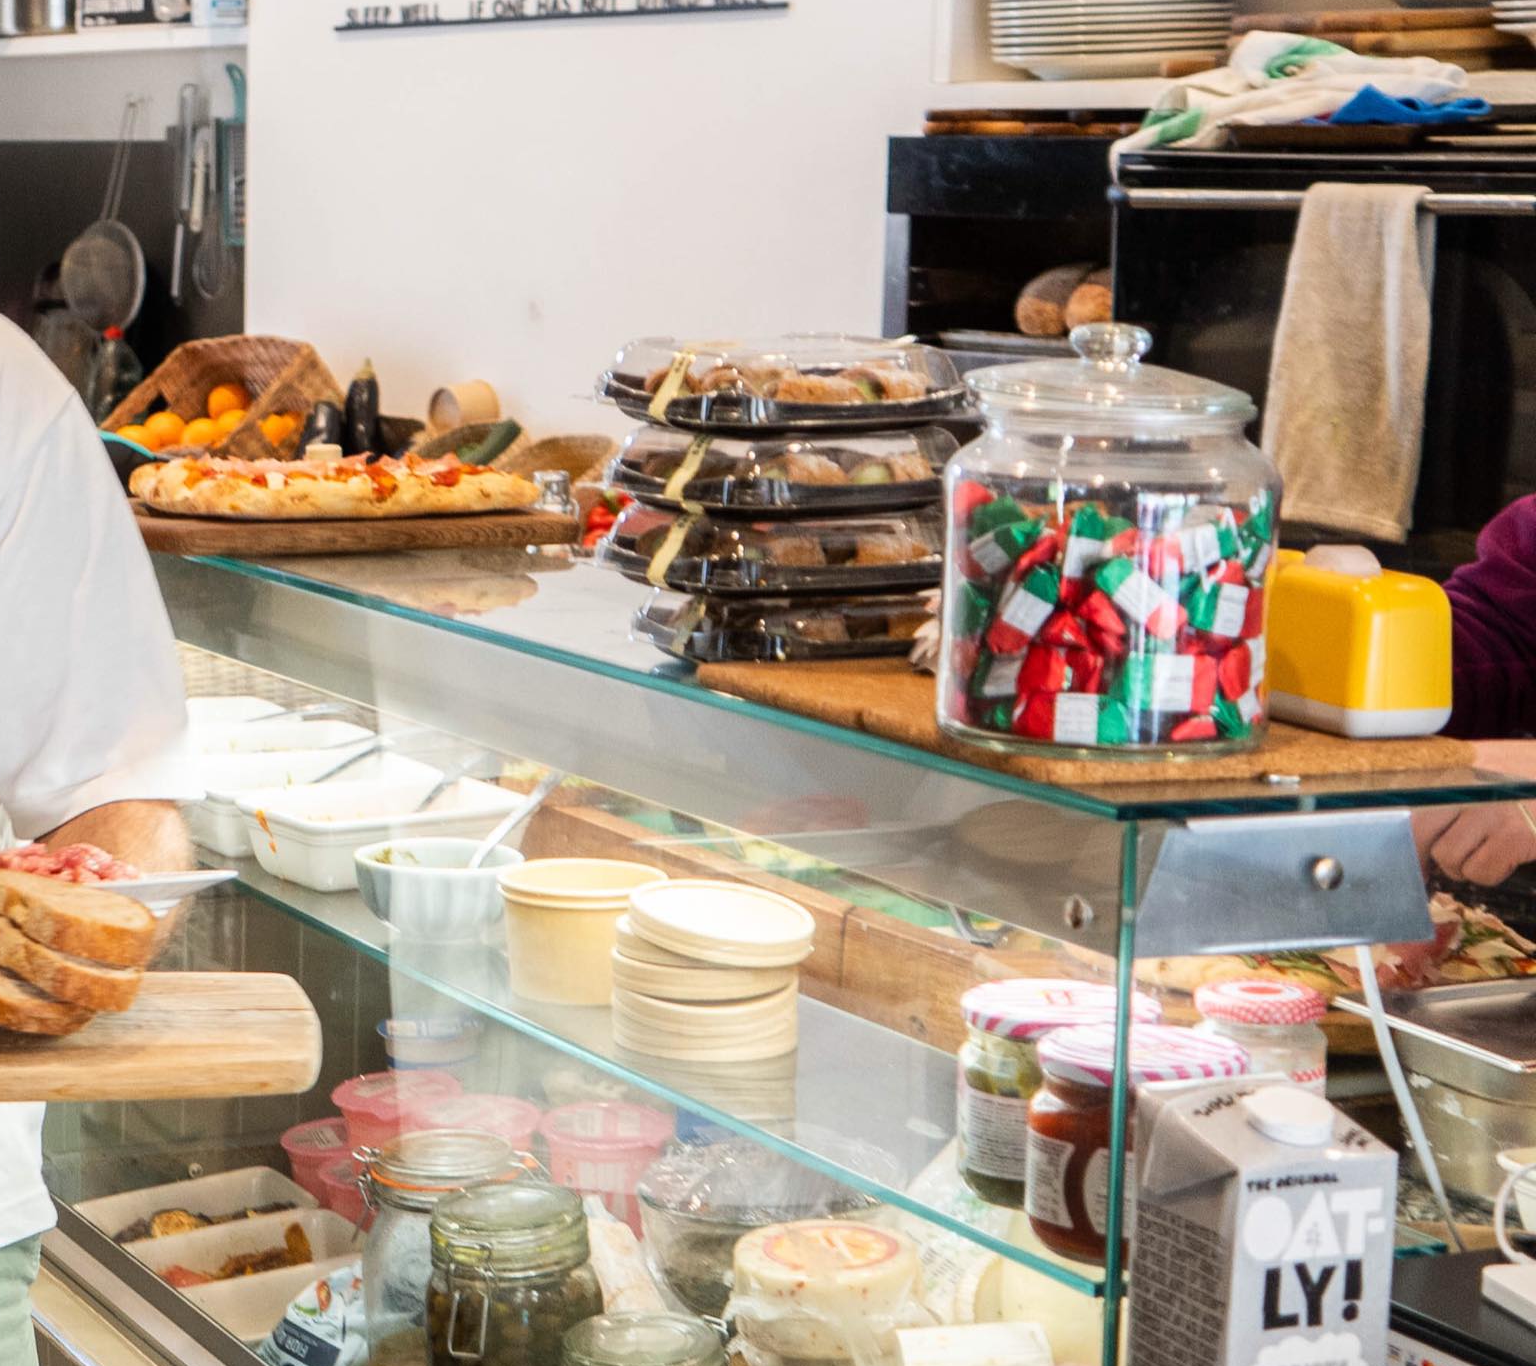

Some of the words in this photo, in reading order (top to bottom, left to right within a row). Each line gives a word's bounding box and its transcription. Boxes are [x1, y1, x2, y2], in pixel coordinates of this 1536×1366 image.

[346, 5, 392, 28] SLEEP
[400, 2, 443, 25] WELL
[469, 0, 486, 21] IF
[1246, 1179, 1273, 1192] THE
[1276, 1173, 1340, 1189] ORIGINAL
[1263, 1258, 1363, 1331] LY!
